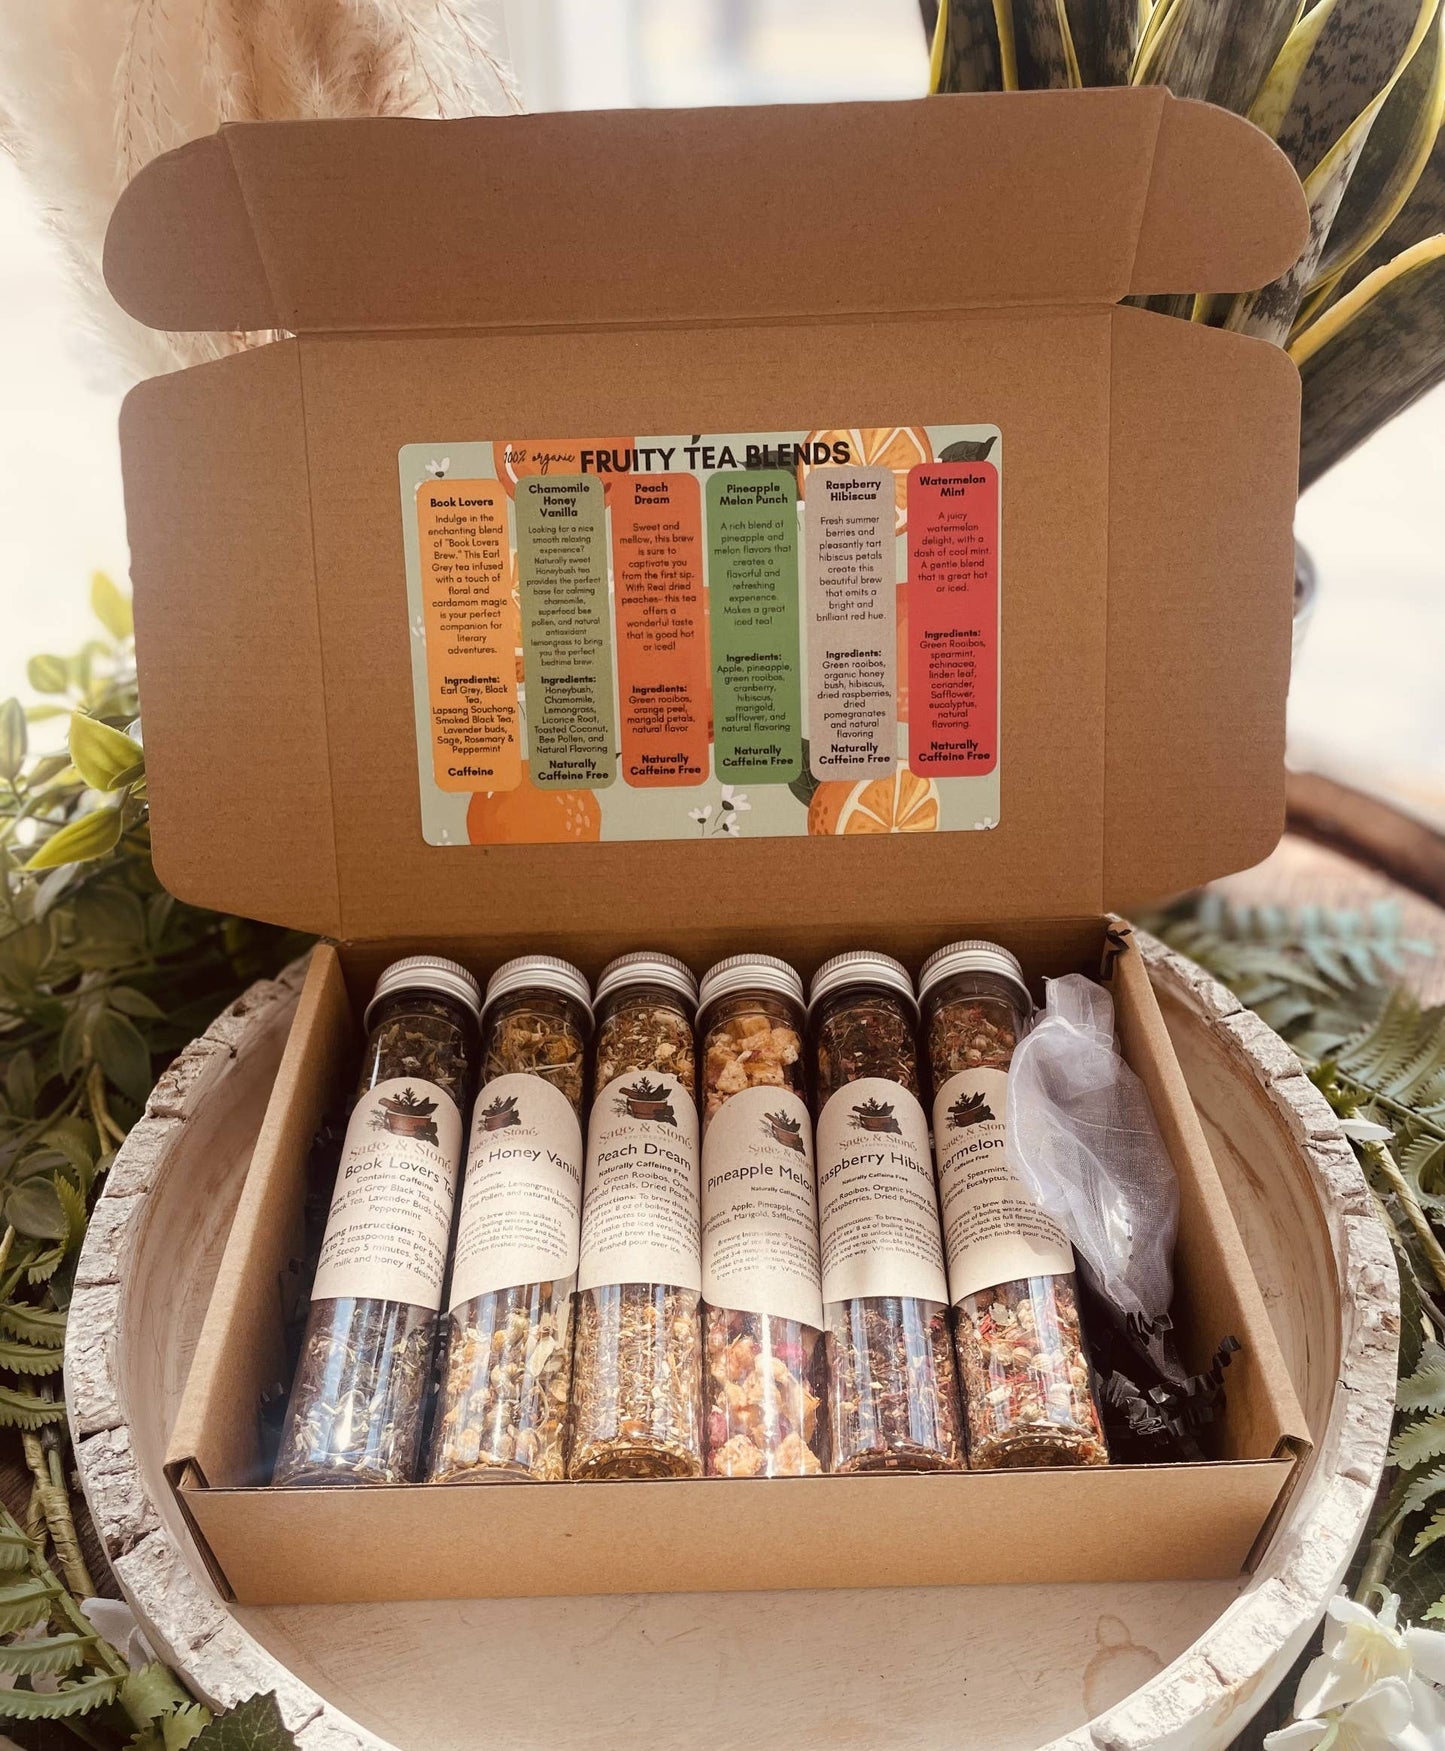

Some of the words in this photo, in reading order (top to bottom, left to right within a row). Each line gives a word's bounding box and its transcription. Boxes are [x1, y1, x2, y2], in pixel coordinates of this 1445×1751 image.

[580, 446, 674, 473] FRUITY
[684, 444, 737, 470] TEA
[746, 441, 850, 468] BLENDS
[532, 452, 575, 474] organic
[920, 474, 986, 486] Watermelon
[528, 483, 590, 494] Chamomile
[635, 483, 668, 493] Peach
[727, 483, 780, 496] Pineapple
[826, 480, 881, 493] Raspberry
[830, 491, 876, 501] Hibiscus
[940, 487, 964, 497] Mint
[430, 498, 456, 508] Book
[459, 498, 493, 507] Lovers
[543, 496, 576, 508] Honey
[634, 495, 670, 504] Dream
[720, 496, 753, 505] Melon
[756, 494, 788, 504] Punch
[540, 507, 578, 518] Vanilla
[436, 514, 468, 525] Indulge
[470, 514, 478, 522] in
[480, 514, 494, 522] the
[820, 516, 843, 525] Fresh
[846, 516, 880, 524] summer
[428, 526, 476, 538] enchanting
[479, 525, 503, 534] blend
[927, 523, 978, 532] watermelon
[532, 536, 559, 544] smooth
[562, 535, 591, 544] relaxing
[655, 534, 670, 542] this
[673, 534, 694, 542] brew
[721, 533, 766, 544] pineapple
[768, 532, 784, 541] and
[819, 540, 863, 550] pleasantly
[866, 540, 882, 548] tart
[819, 552, 853, 561] hibiscus
[856, 551, 882, 562] petals
[432, 563, 452, 574] Grey
[455, 563, 469, 571] tea
[472, 562, 503, 571] infused
[628, 558, 669, 569] captivate
[672, 560, 687, 569] you
[732, 581, 775, 592] refreshing
[432, 598, 479, 607] cardamom
[482, 598, 507, 609] magic
[816, 612, 848, 622] brilliant
[851, 612, 865, 620] red
[925, 630, 980, 640] Ingredients:
[920, 640, 947, 649] Green
[726, 653, 782, 663] Ingredients:
[826, 650, 882, 660] Ingredients:
[822, 660, 849, 669] Green
[824, 670, 856, 680] organic
[859, 670, 884, 680] honey
[444, 676, 500, 686] Ingredients:
[541, 676, 596, 685] Ingredients:
[441, 686, 457, 694] Earl
[485, 686, 508, 694] Black
[632, 685, 687, 694] Ingredients:
[817, 690, 839, 699] dried
[629, 696, 655, 704] Green
[432, 706, 468, 716] Lapsang
[634, 706, 664, 715] orange
[824, 710, 886, 720] pomegranates
[436, 716, 470, 724] Smoked
[473, 716, 495, 724] Black
[627, 715, 664, 725] marigold
[444, 726, 482, 734] Lavender
[534, 726, 566, 734] Toasted
[632, 725, 662, 733] natural
[664, 724, 689, 733] flavor
[722, 723, 752, 732] natural
[754, 722, 790, 732] flavoring
[836, 729, 873, 739] flavoring
[452, 745, 500, 755] Peppermint
[831, 744, 878, 756] Naturally
[931, 740, 978, 752] Naturally
[734, 746, 781, 757] Naturally
[642, 754, 688, 766] Naturally
[723, 757, 768, 767] Caffeine
[771, 757, 793, 765] Free
[819, 755, 864, 765] Caffeine
[868, 755, 890, 763] Free
[919, 752, 964, 762] Caffeine
[967, 752, 990, 760] Free
[550, 759, 596, 771] Naturally
[448, 767, 493, 777] Caffeine
[538, 771, 583, 780] Caffeine
[586, 771, 608, 780] Free
[630, 766, 676, 776] Caffeine
[678, 766, 701, 774] Free
[598, 1144, 637, 1167] Peach
[644, 1143, 691, 1171] Dream
[975, 1154, 989, 1162] Free
[345, 1158, 382, 1179] Book
[389, 1157, 439, 1184] Lovers
[489, 1148, 541, 1163] Honey
[546, 1149, 580, 1185] Vanilla
[599, 1162, 633, 1178] Naturally
[637, 1161, 672, 1173] Caffeine
[820, 1153, 884, 1187] Raspberry
[967, 1166, 1008, 1180] Spearmint,
[357, 1174, 396, 1184] Contains
[400, 1174, 434, 1191] Caffeine
[604, 1173, 629, 1186] Green
[631, 1171, 670, 1184] Rooibos,
[707, 1163, 773, 1192] Pineapple
[779, 1165, 814, 1196] Melon
[966, 1175, 1008, 1190] Eucalyptus,
[873, 1184, 904, 1193] Organic
[369, 1204, 421, 1221] Peppermint
[731, 1202, 755, 1212] Apple,
[758, 1201, 794, 1214] Pineapple,
